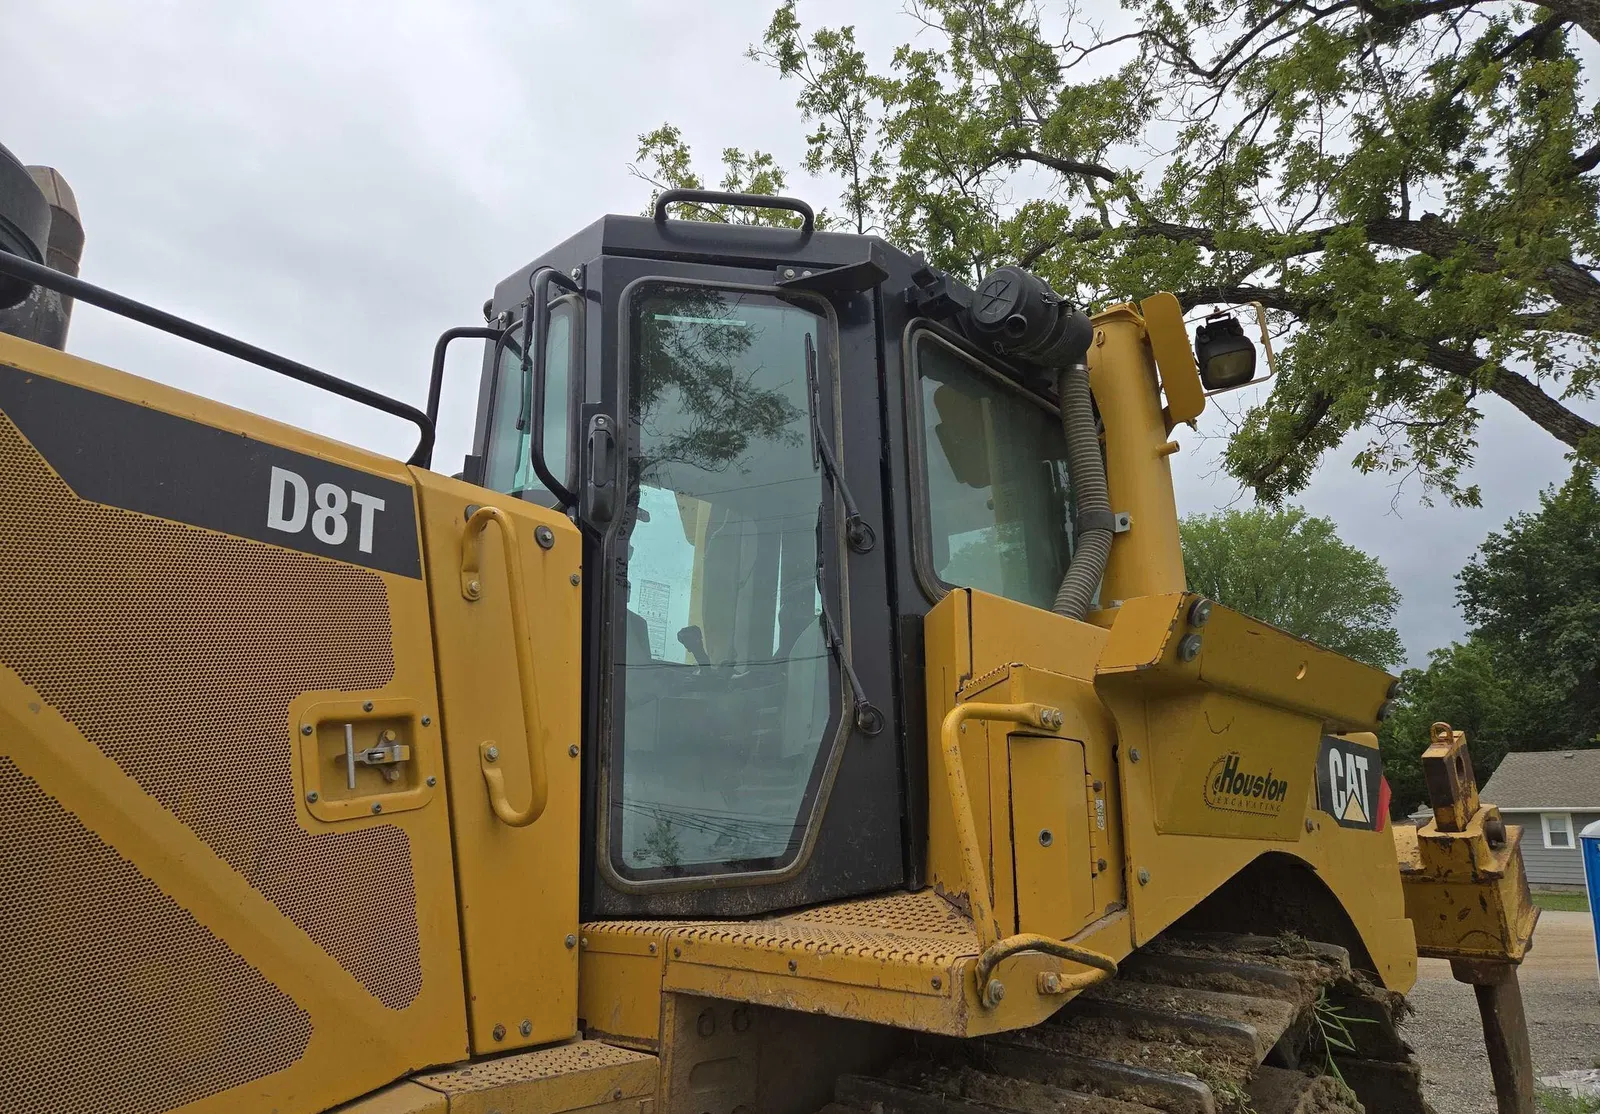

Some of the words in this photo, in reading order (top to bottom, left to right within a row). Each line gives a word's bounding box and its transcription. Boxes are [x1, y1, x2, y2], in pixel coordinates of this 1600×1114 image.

[267, 466, 385, 553] D8T
[1219, 754, 1288, 802] Houston
[1329, 748, 1370, 823] CAT
